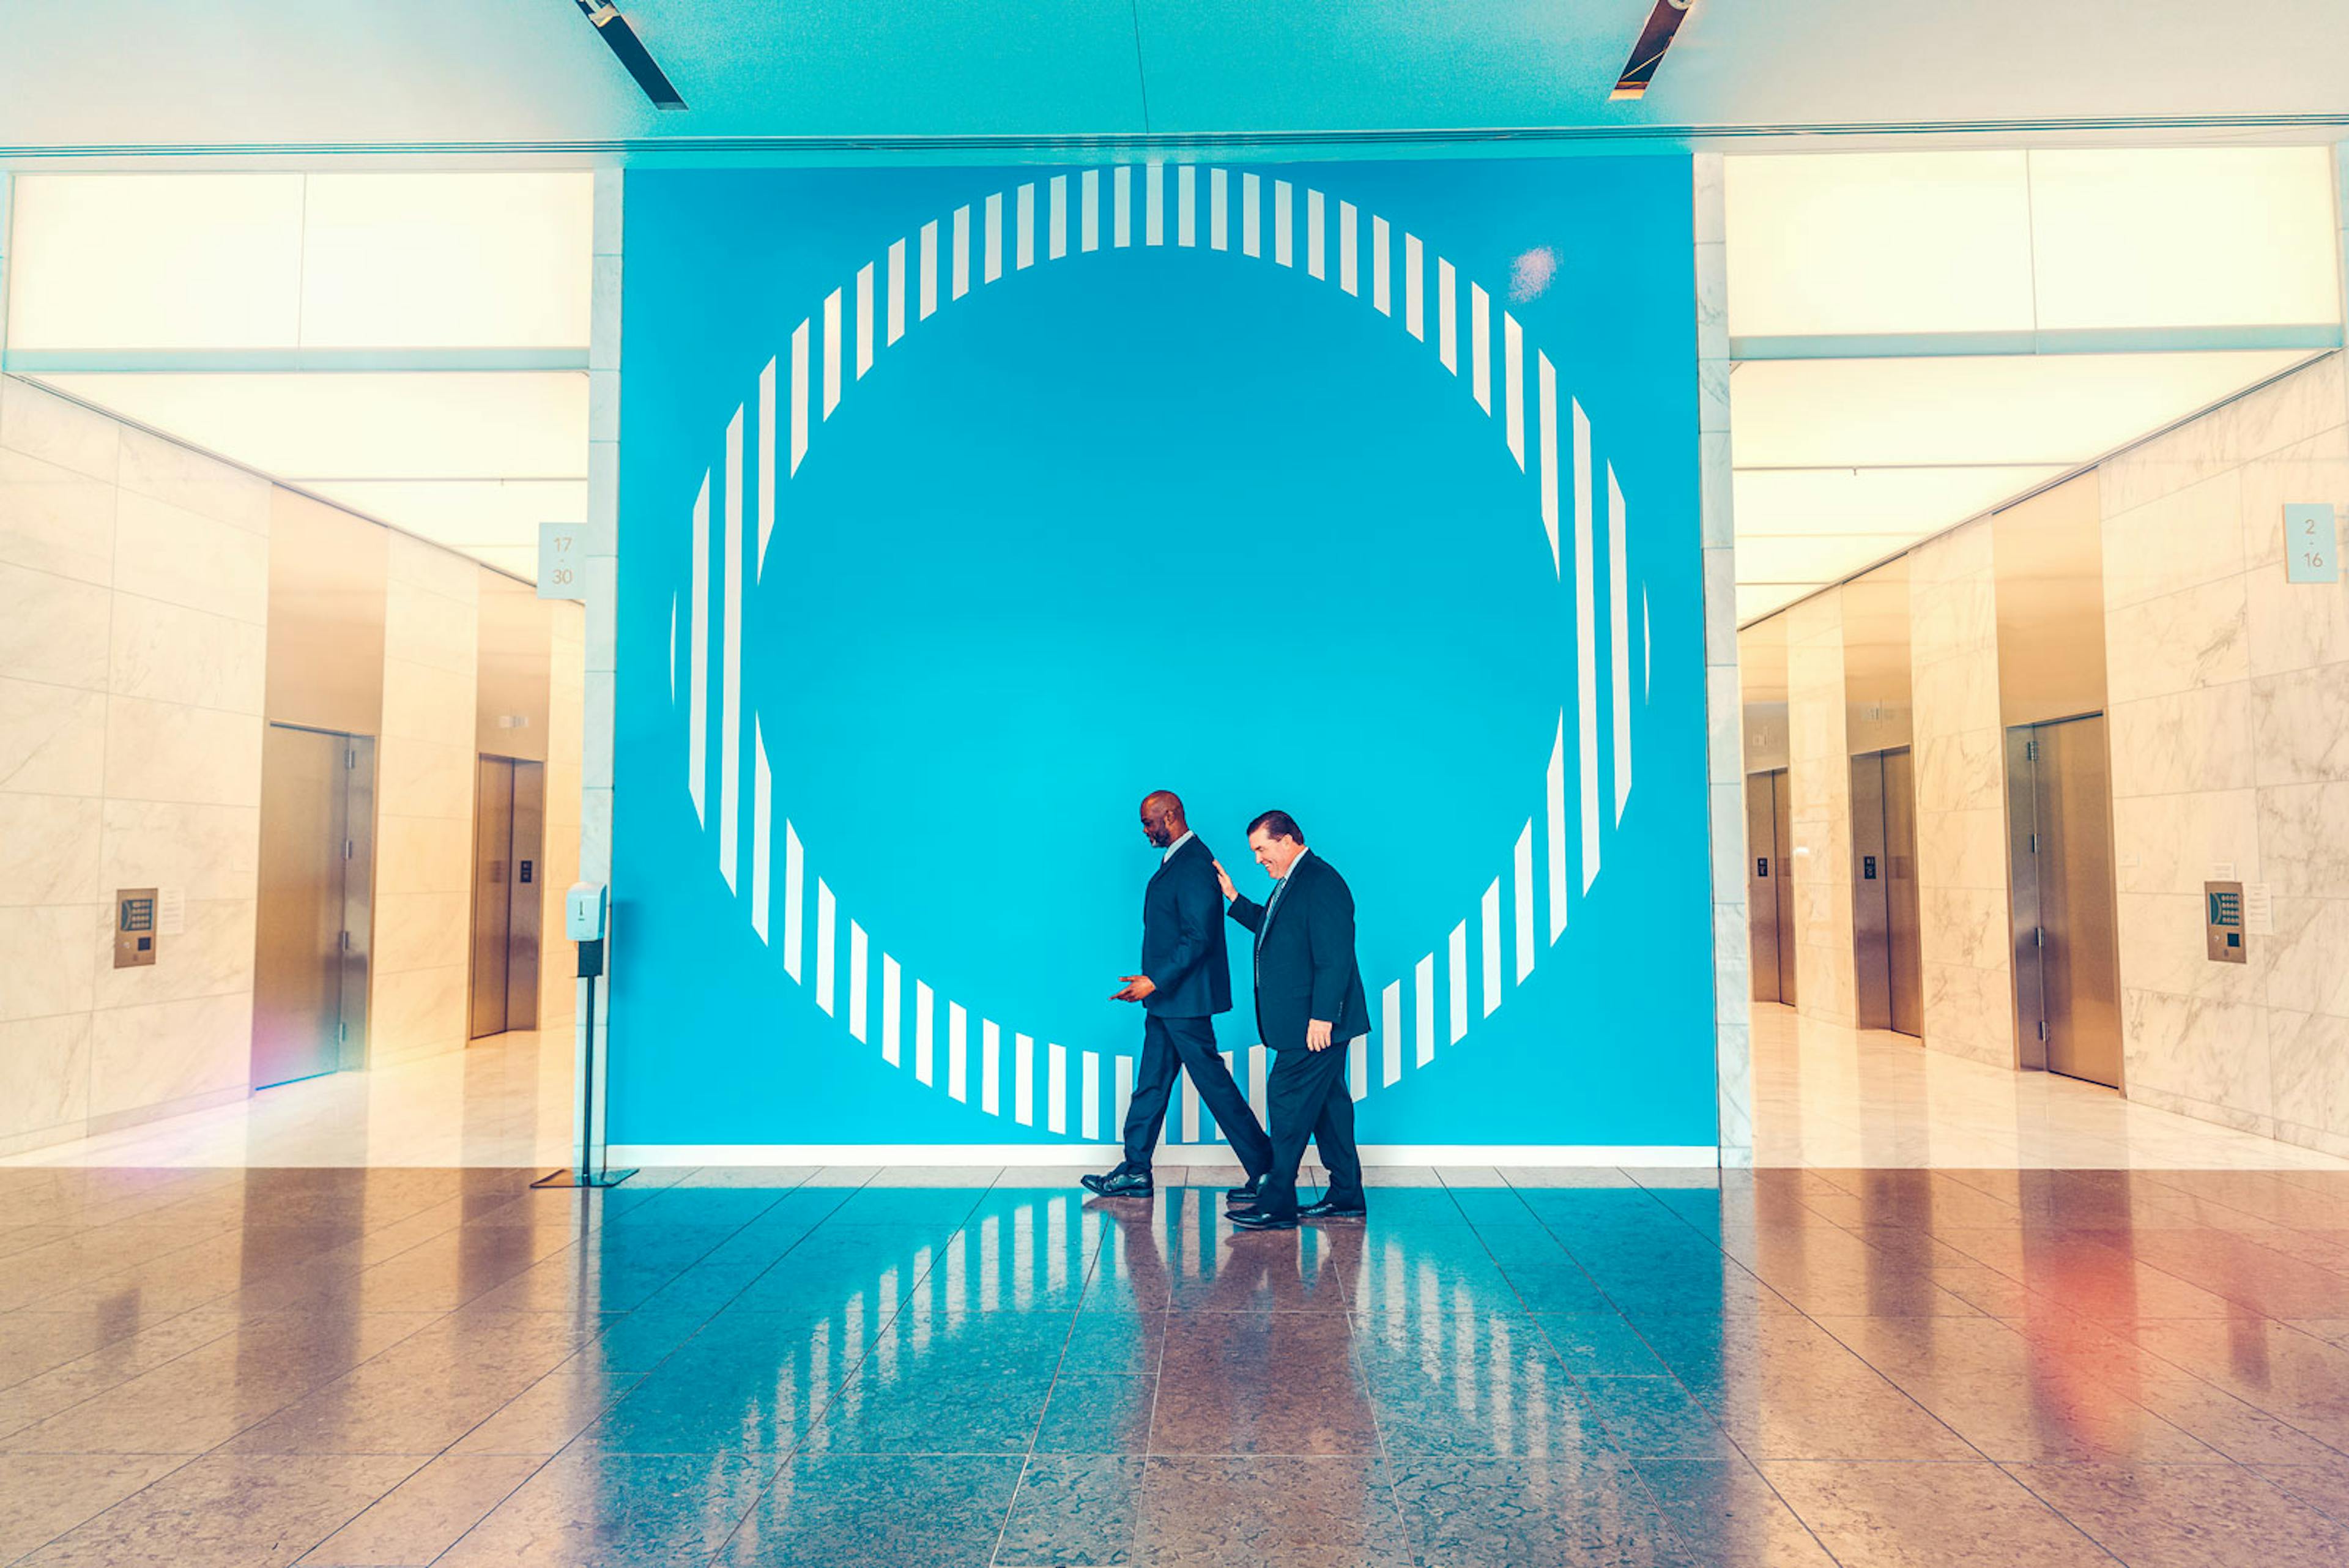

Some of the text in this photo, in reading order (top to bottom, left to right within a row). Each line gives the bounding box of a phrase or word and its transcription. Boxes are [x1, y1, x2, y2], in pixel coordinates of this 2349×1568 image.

[2305, 519, 2315, 534] 2
[554, 537, 573, 552] 17
[2304, 552, 2323, 567] 16
[552, 569, 573, 584] 30
